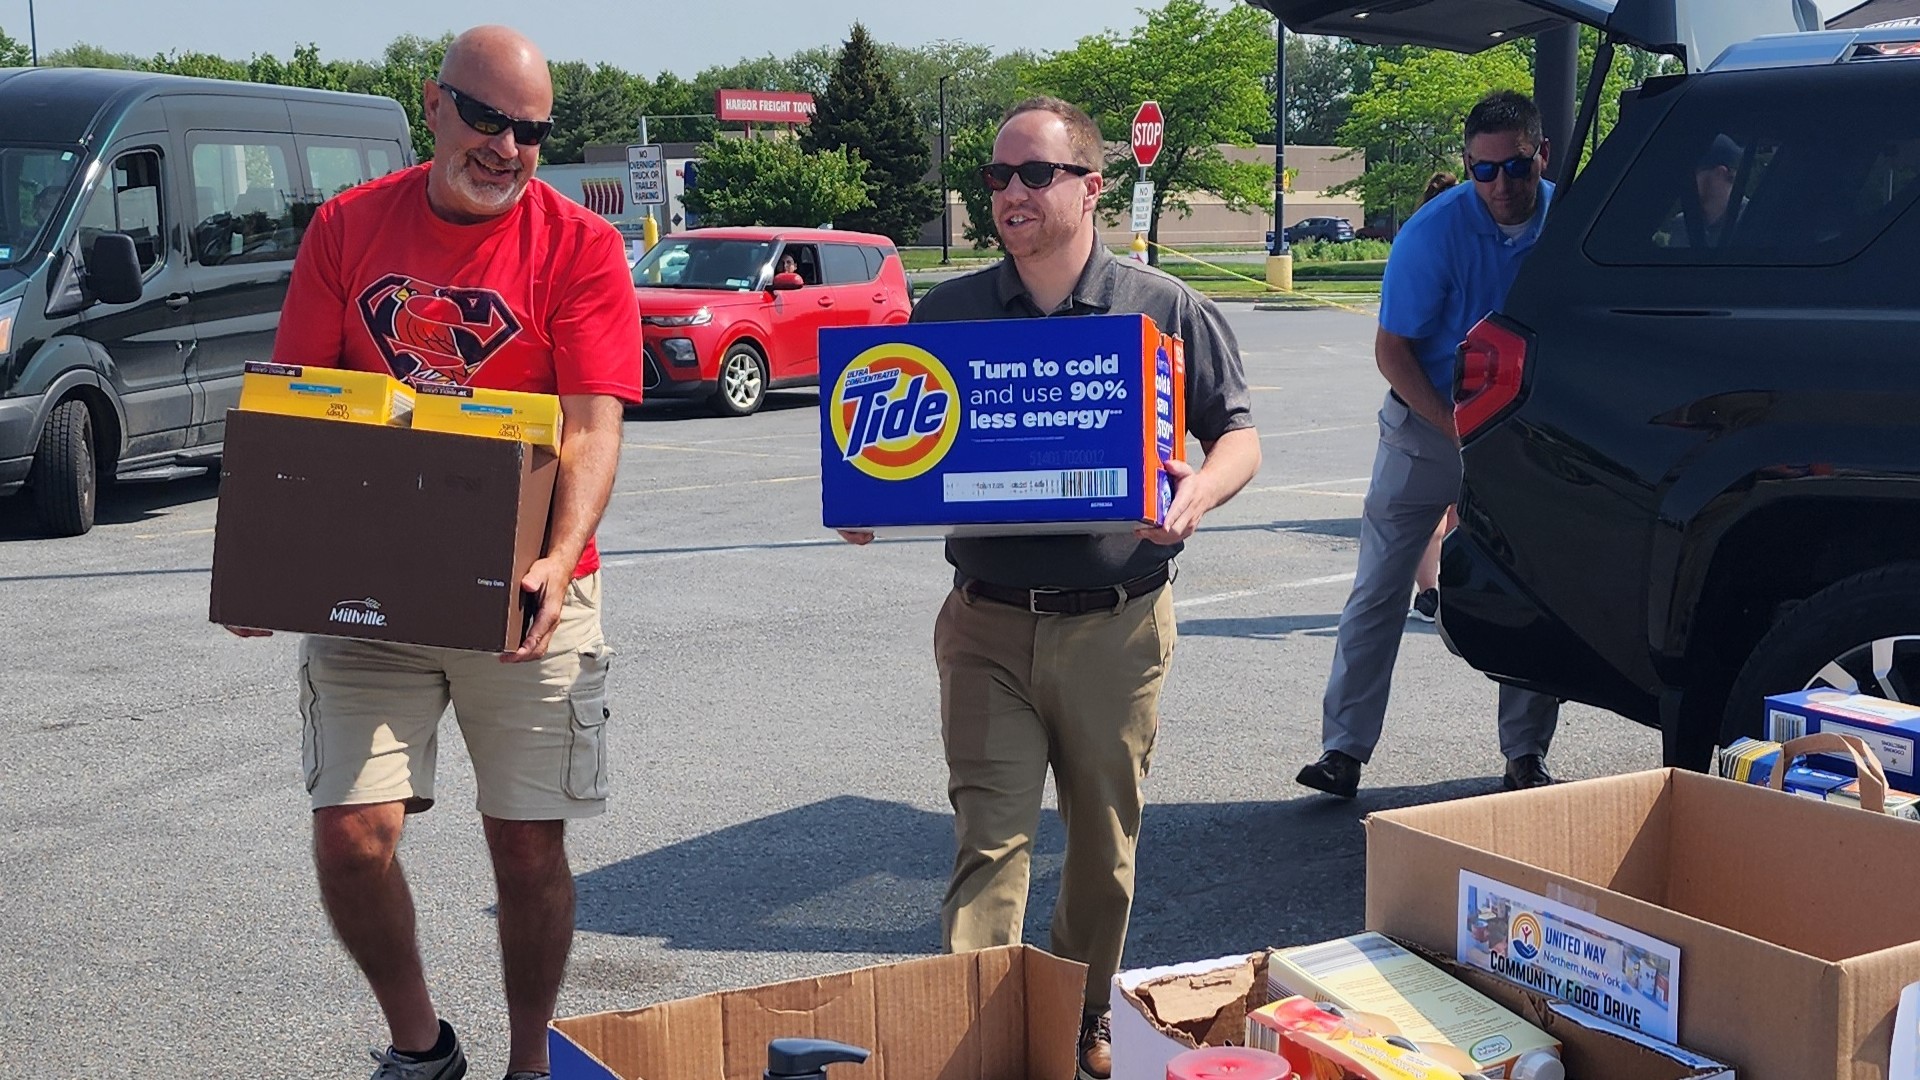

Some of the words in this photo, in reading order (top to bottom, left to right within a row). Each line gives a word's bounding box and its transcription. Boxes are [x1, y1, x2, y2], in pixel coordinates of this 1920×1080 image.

[726, 99, 757, 111] HARBOR
[760, 100, 791, 112] FREIGHT
[1134, 122, 1161, 147] STOP
[639, 150, 648, 158] NO
[630, 160, 660, 169] OVERNIGHT
[632, 171, 649, 180] TRUCK
[650, 170, 660, 178] OR
[635, 181, 658, 190] TRAILER
[1139, 187, 1148, 196] NO
[634, 191, 660, 200] PARKING
[846, 367, 869, 379] ULTRA
[969, 360, 1027, 379] Turn
[1032, 358, 1060, 377] to
[1065, 353, 1119, 376] cold
[845, 368, 900, 387] CONCENTRATED
[970, 383, 1014, 405] and
[1022, 386, 1063, 403] use
[1070, 379, 1128, 401] 90%
[325, 409, 350, 420] Crispy
[842, 374, 949, 461] Tide
[970, 409, 1017, 429] less
[329, 607, 386, 627] Millville
[1545, 926, 1581, 956] UNITED
[1583, 942, 1607, 965] WAY
[1543, 951, 1580, 973] Northern
[1581, 966, 1600, 981] New
[1601, 971, 1621, 988] York
[1490, 950, 1562, 994] COMMUNITY
[1603, 996, 1642, 1028] DRIVE
